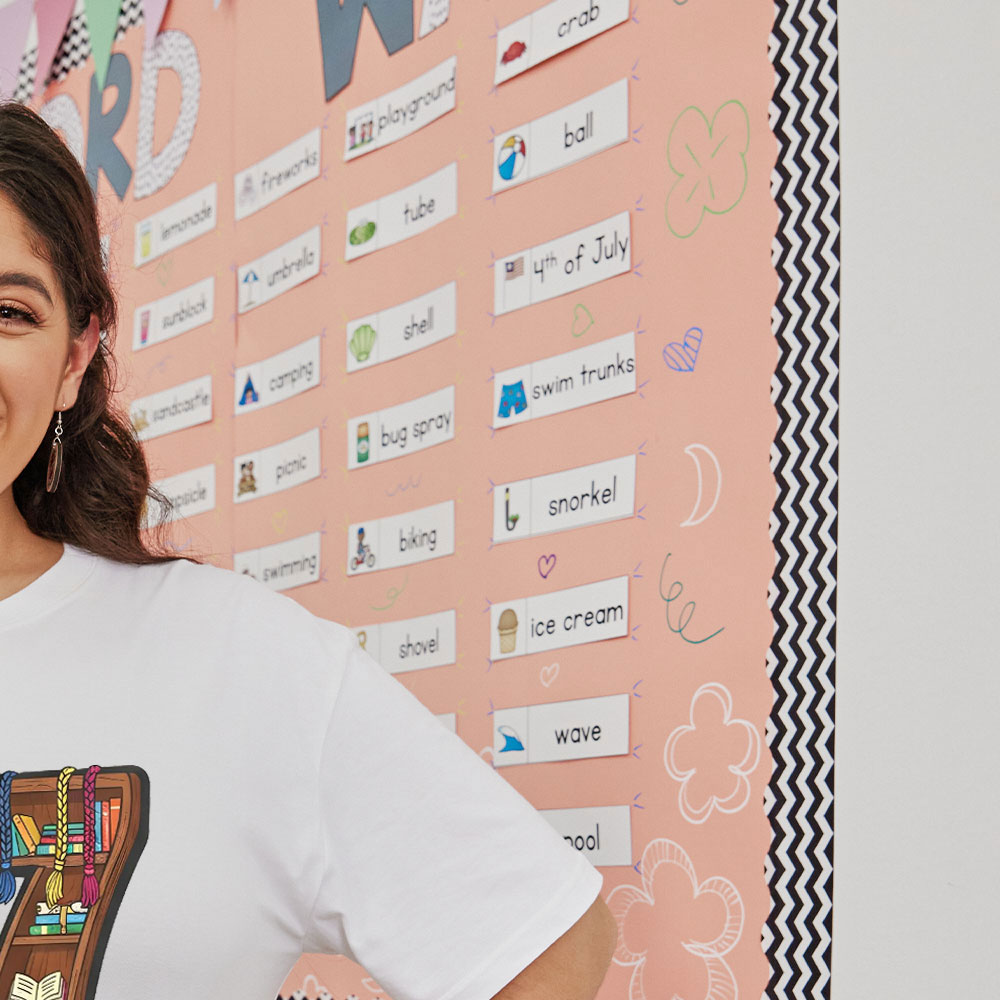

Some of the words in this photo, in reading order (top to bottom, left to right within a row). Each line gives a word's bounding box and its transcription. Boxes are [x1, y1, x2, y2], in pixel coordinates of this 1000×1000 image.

[557, 0, 600, 38] crab
[377, 65, 457, 137] playground
[563, 111, 594, 149] ball
[261, 148, 319, 193] fireworks
[403, 194, 436, 226] tube
[266, 247, 315, 288] umbrella
[533, 251, 558, 284] 4th
[564, 243, 586, 275] of
[591, 230, 629, 265] July
[403, 305, 434, 341] shell
[269, 361, 314, 393] camping
[531, 375, 575, 400] swim
[580, 351, 636, 387] trunks
[379, 423, 408, 449] bug
[412, 410, 452, 442] spray
[275, 456, 307, 485] picnic
[547, 474, 618, 518] snorkel
[398, 526, 438, 553] biking
[262, 554, 318, 582] swimming
[531, 617, 557, 639] ice
[562, 603, 624, 634] cream
[398, 627, 440, 660] shovel
[554, 724, 602, 745] wave
